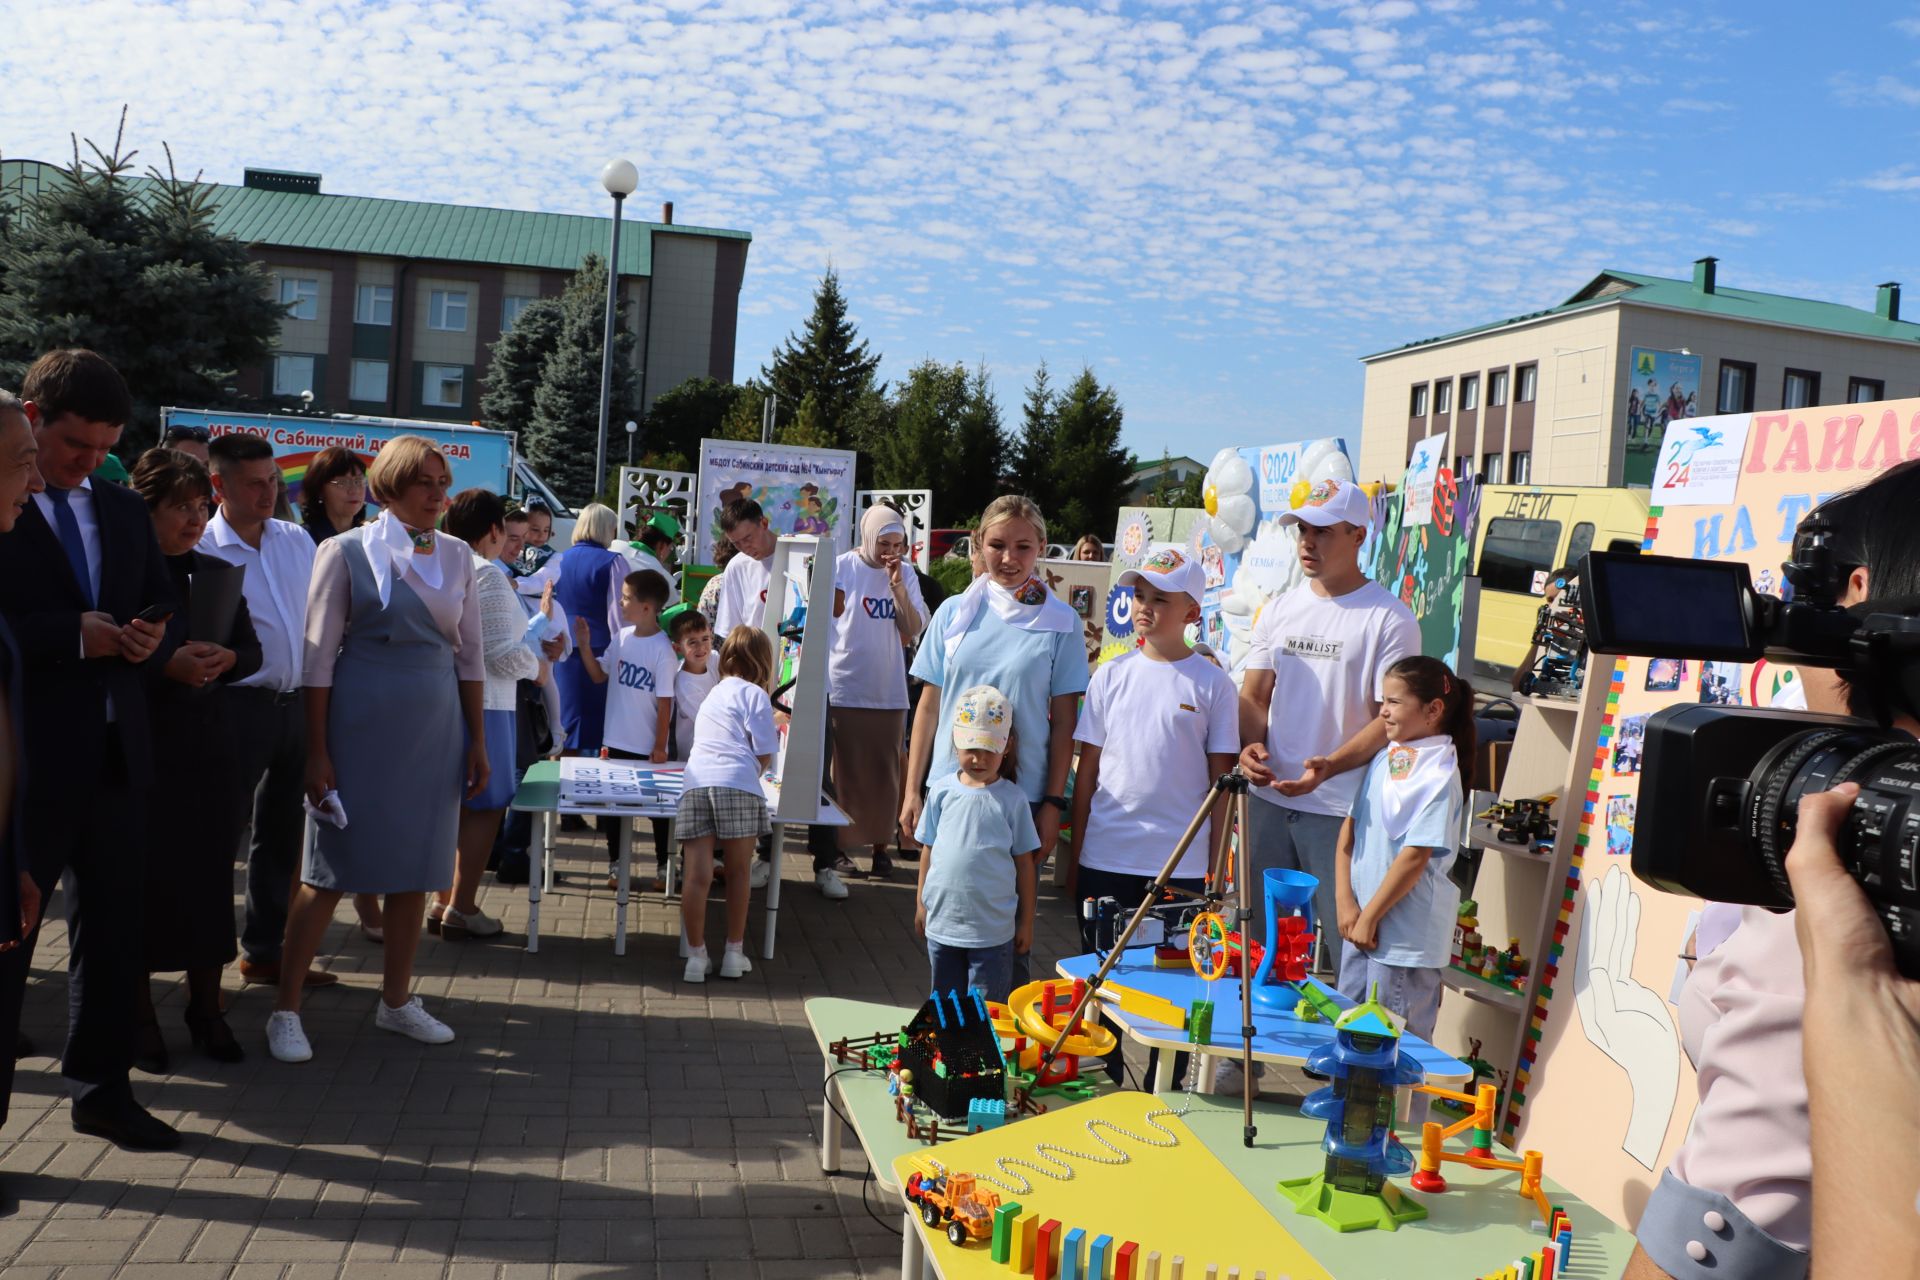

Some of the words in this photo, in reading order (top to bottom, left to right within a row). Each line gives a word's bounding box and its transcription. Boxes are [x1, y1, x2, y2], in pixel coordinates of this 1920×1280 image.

[274, 429, 365, 450] Сабинский
[441, 444, 470, 458] сад
[709, 457, 731, 468] МБДОУ
[732, 459, 763, 471] Сабинский
[789, 464, 800, 476] сад
[1266, 450, 1296, 484] 2024
[1663, 462, 1690, 488] 24
[1504, 492, 1553, 521] ДЕТИ
[1692, 504, 1758, 560] ИЛ
[869, 598, 896, 619] 202
[1288, 641, 1339, 654] MANLIST
[619, 660, 656, 693] 2024
